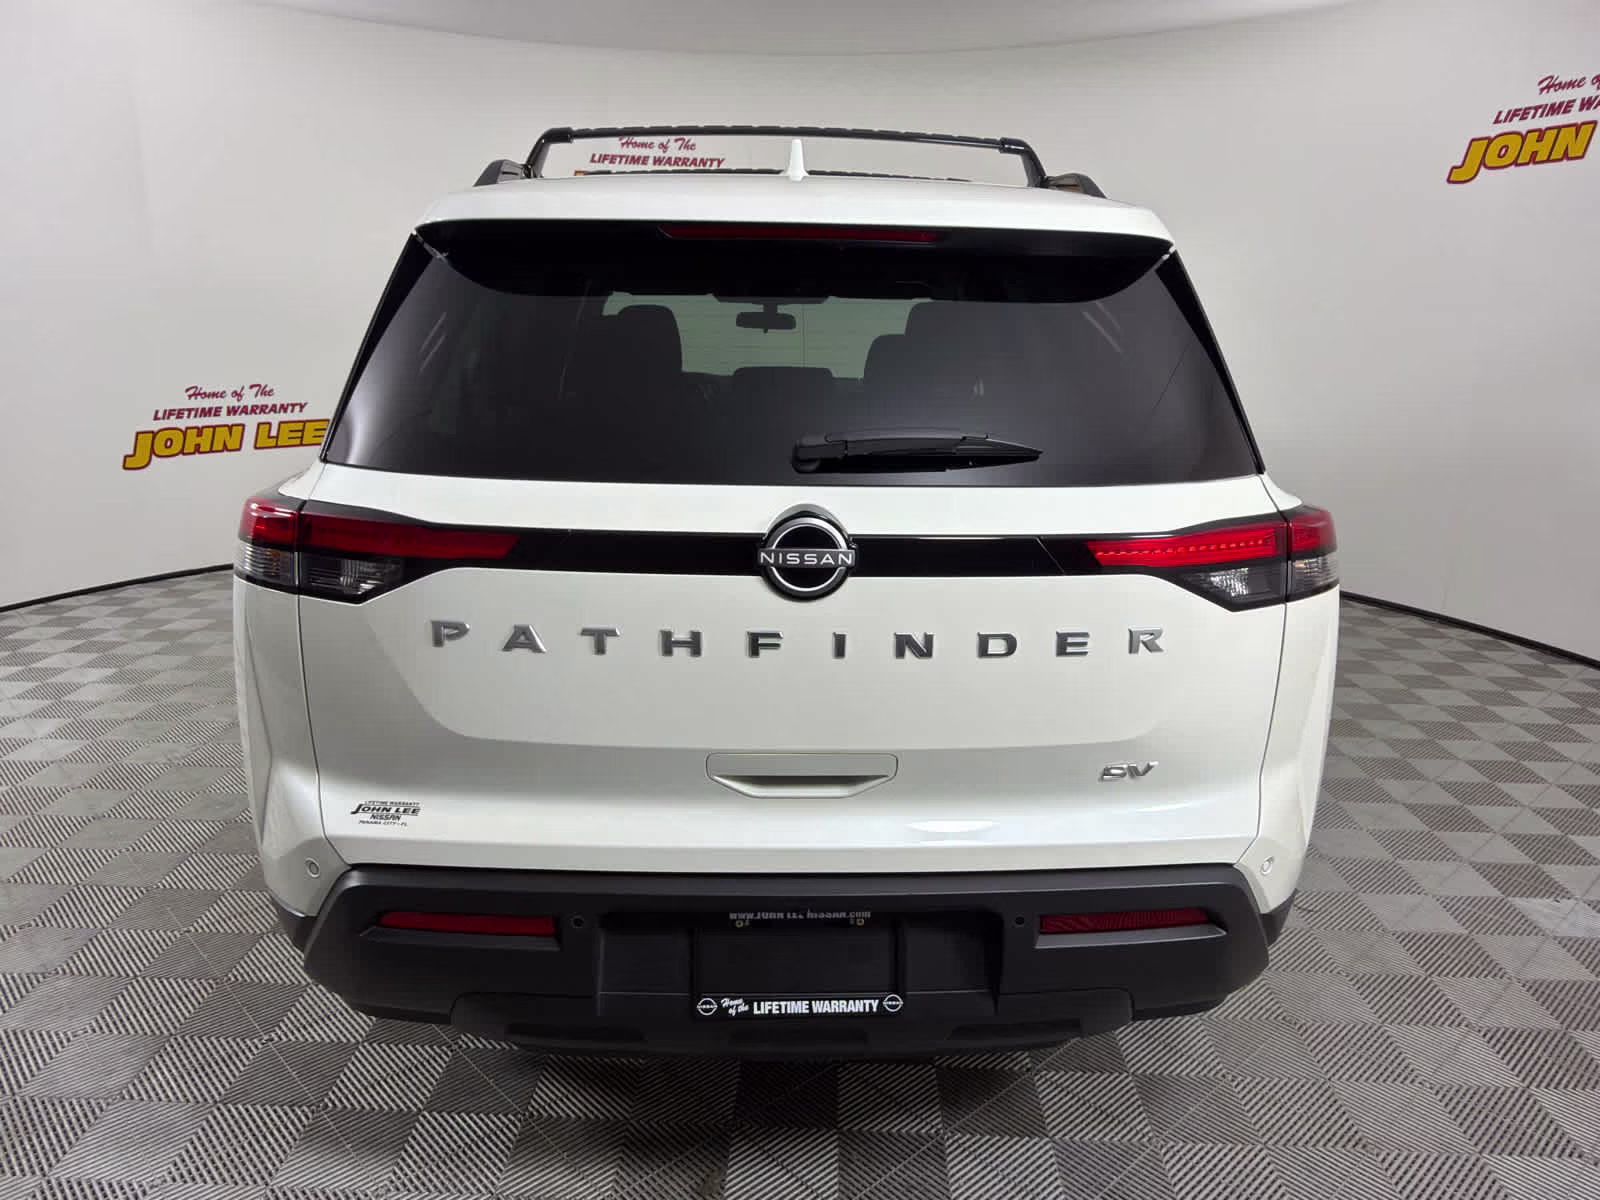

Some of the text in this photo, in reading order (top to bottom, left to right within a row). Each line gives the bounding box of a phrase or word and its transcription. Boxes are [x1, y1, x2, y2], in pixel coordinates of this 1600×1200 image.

[1538, 75, 1586, 95] Home
[1493, 99, 1576, 125] LIFETIME
[618, 136, 696, 153] Home of The
[1447, 120, 1598, 184] JOHN
[590, 153, 725, 169] LIFETIME WARRANTY
[185, 384, 275, 402] Home of The
[153, 402, 308, 421] LIFETIME WARRANTY
[122, 419, 330, 470] JOHN LEE
[760, 552, 853, 565] NISSAN
[431, 619, 1165, 659] PATHFINDER
[1098, 761, 1159, 781] SV
[350, 804, 392, 814] JOHN
[753, 999, 879, 1014] LIFETIME WARRANTY
